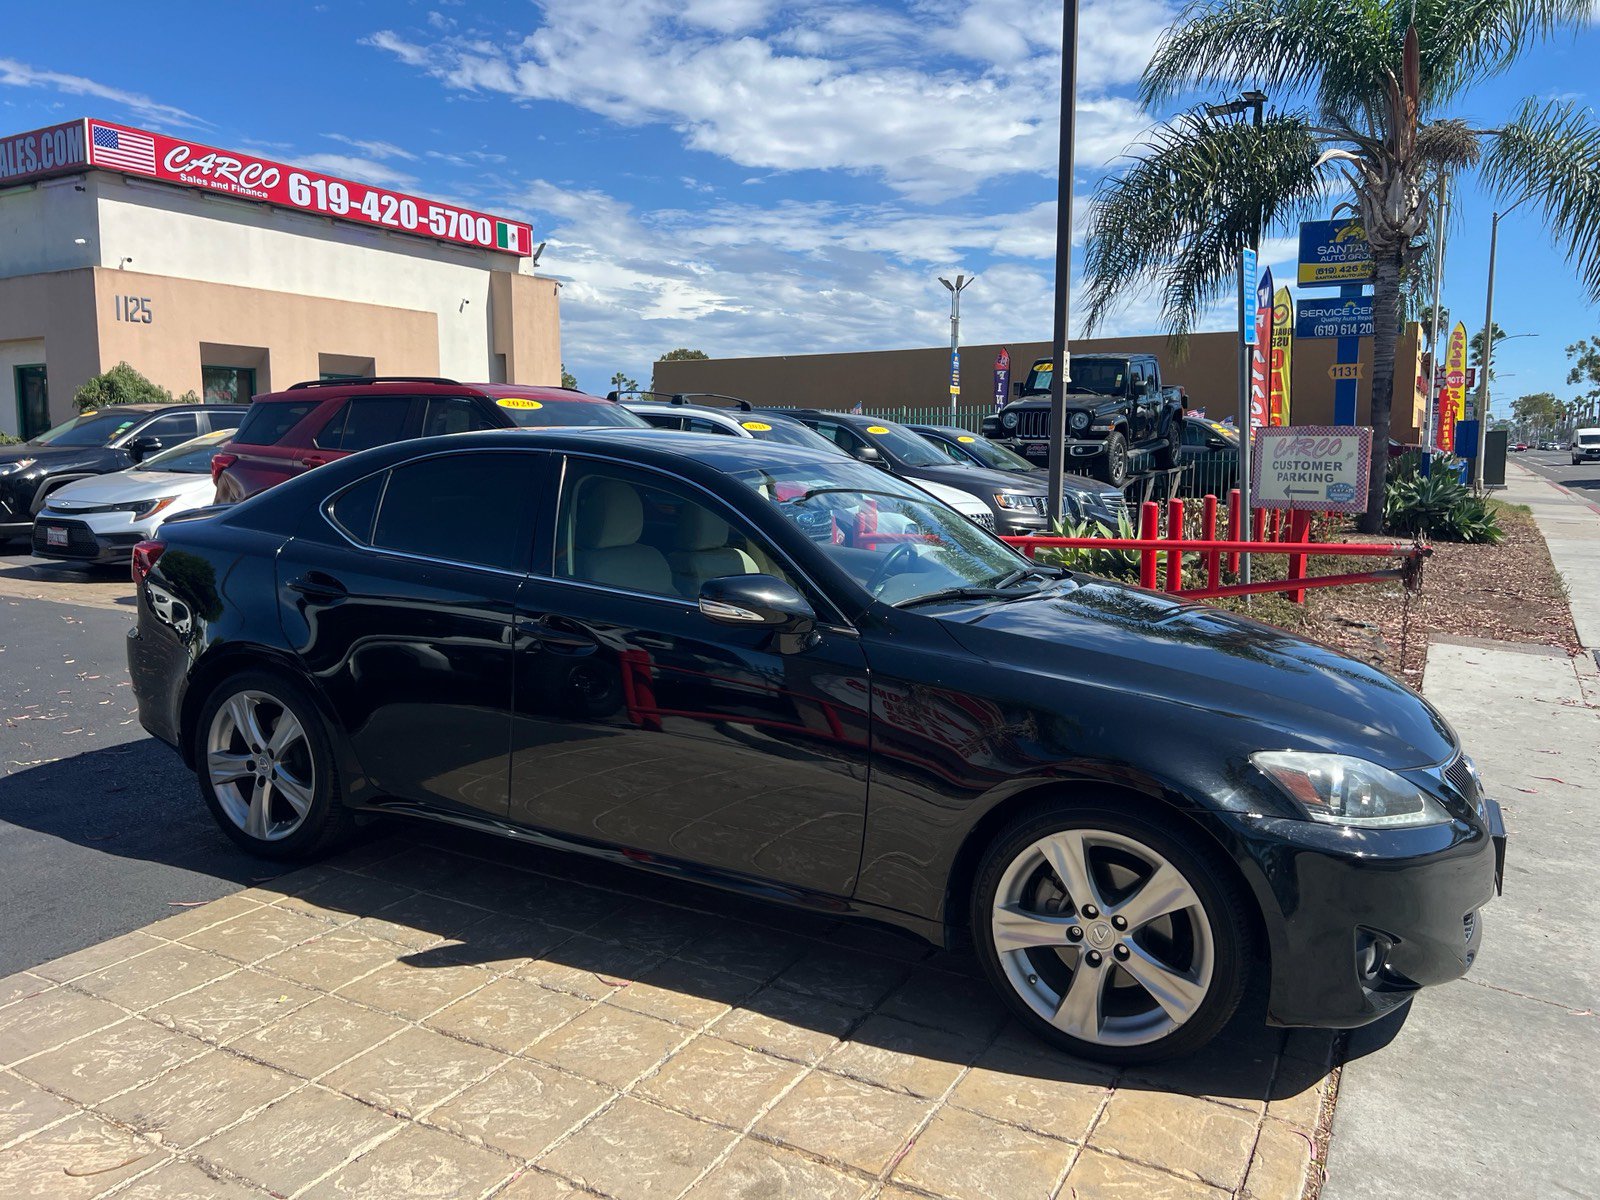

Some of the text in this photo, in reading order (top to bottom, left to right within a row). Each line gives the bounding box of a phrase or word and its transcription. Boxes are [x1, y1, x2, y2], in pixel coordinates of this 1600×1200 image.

[163, 145, 280, 189] CARCO
[180, 173, 268, 199] Sales and Finance
[288, 172, 492, 246] 619-420-5700
[1317, 243, 1371, 255] SANTA
[1315, 267, 1337, 276] (619)
[1339, 265, 1358, 273] 426
[115, 295, 153, 324] 1125
[1300, 308, 1349, 318] SERVICE
[1314, 324, 1338, 336] (619)
[1340, 323, 1357, 335] 614
[1332, 366, 1358, 378] 1131
[506, 400, 534, 408] 2020
[1273, 437, 1343, 459] CARCO
[1272, 460, 1343, 471] CUSTOMER
[1277, 472, 1334, 483] PARKING
